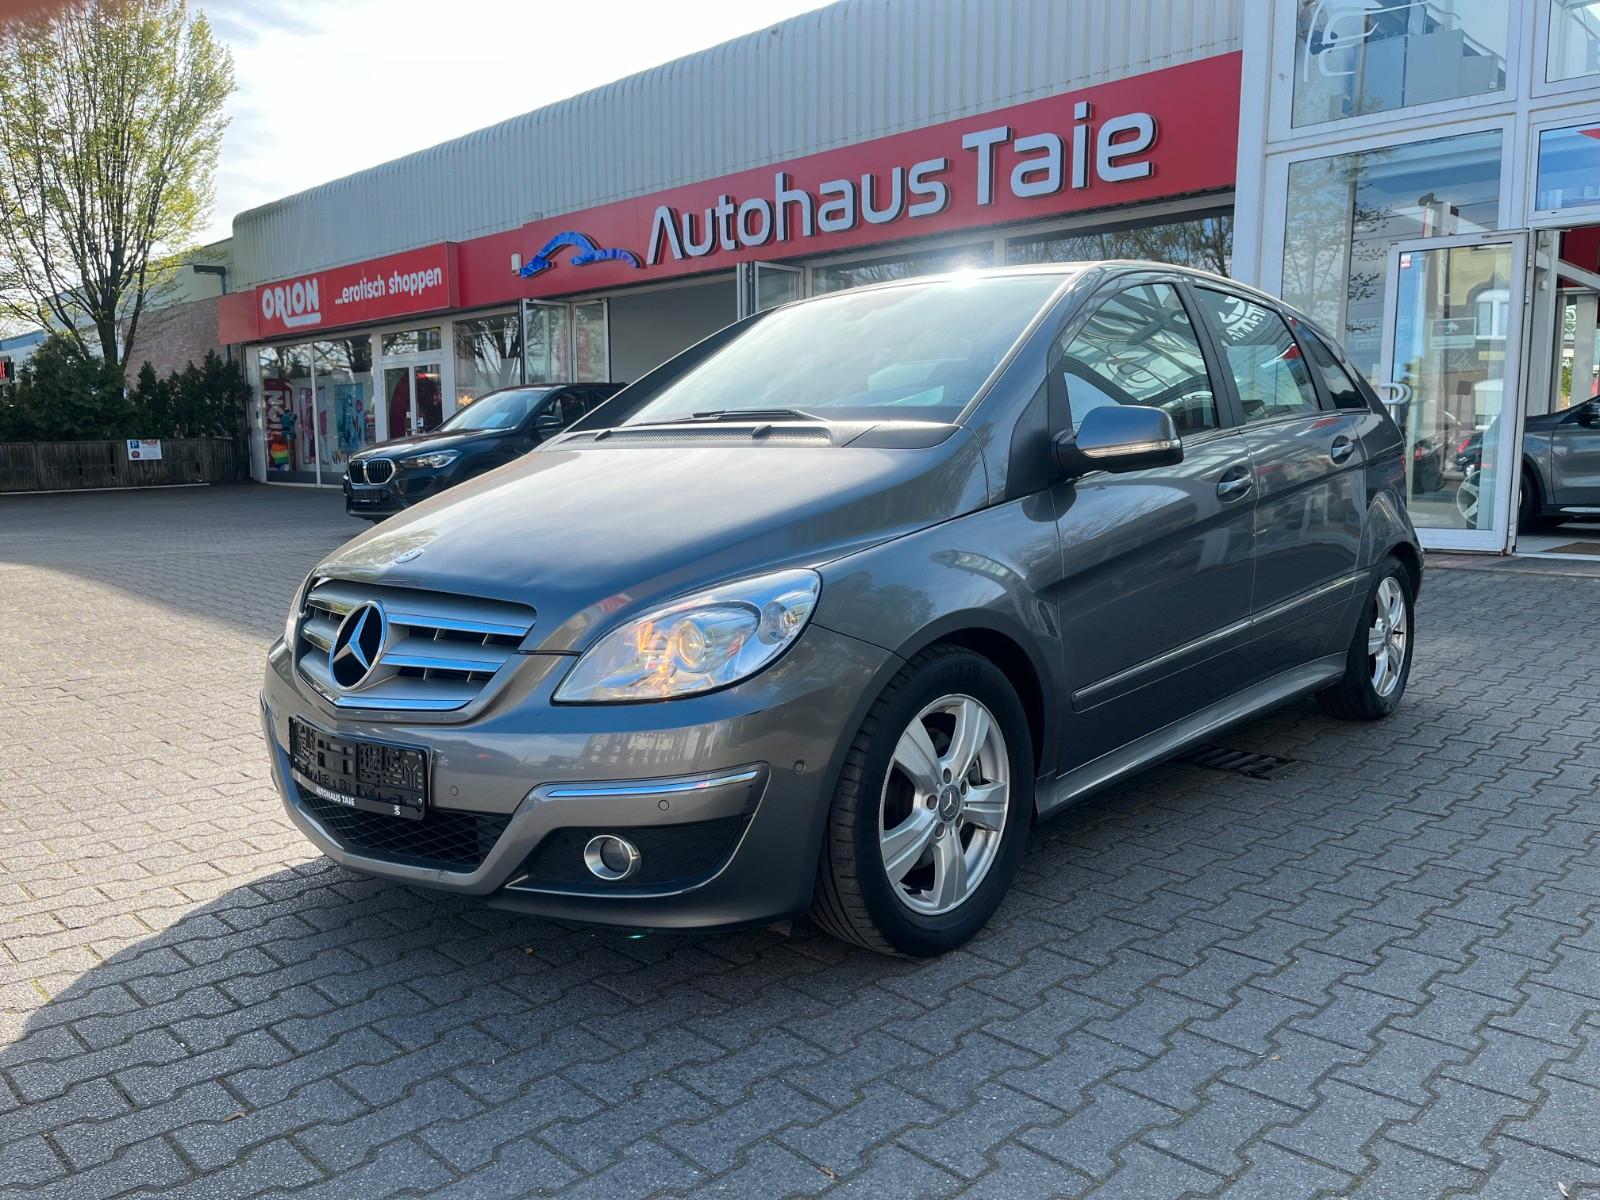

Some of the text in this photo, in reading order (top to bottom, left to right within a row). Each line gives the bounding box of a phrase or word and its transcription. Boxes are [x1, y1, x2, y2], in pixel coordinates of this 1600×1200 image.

[646, 100, 1158, 265] Autohaus Taie
[261, 278, 321, 328] ORION
[388, 267, 442, 296] shoppen
